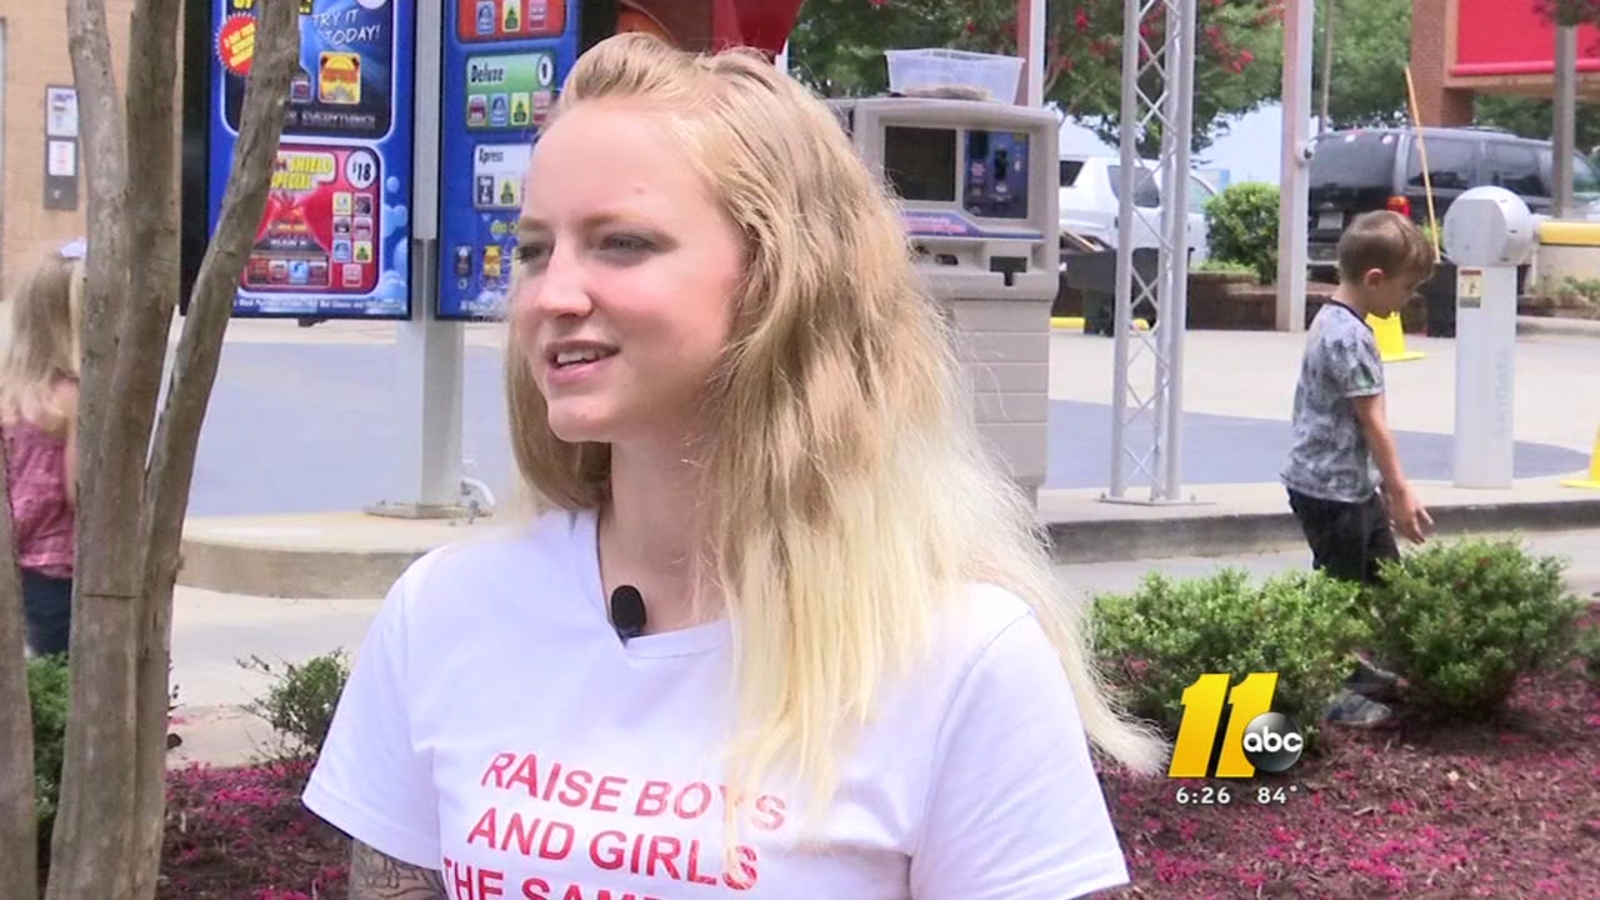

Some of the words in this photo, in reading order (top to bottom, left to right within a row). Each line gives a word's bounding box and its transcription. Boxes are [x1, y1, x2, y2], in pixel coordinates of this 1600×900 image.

[312, 11, 341, 27] TRY
[346, 9, 358, 24] IT
[319, 25, 380, 45] TODAY!
[470, 64, 504, 83] Deluxe
[352, 161, 372, 181] $18
[480, 752, 628, 812] RAISE
[466, 806, 576, 861] AND
[589, 830, 758, 891] GIRLS
